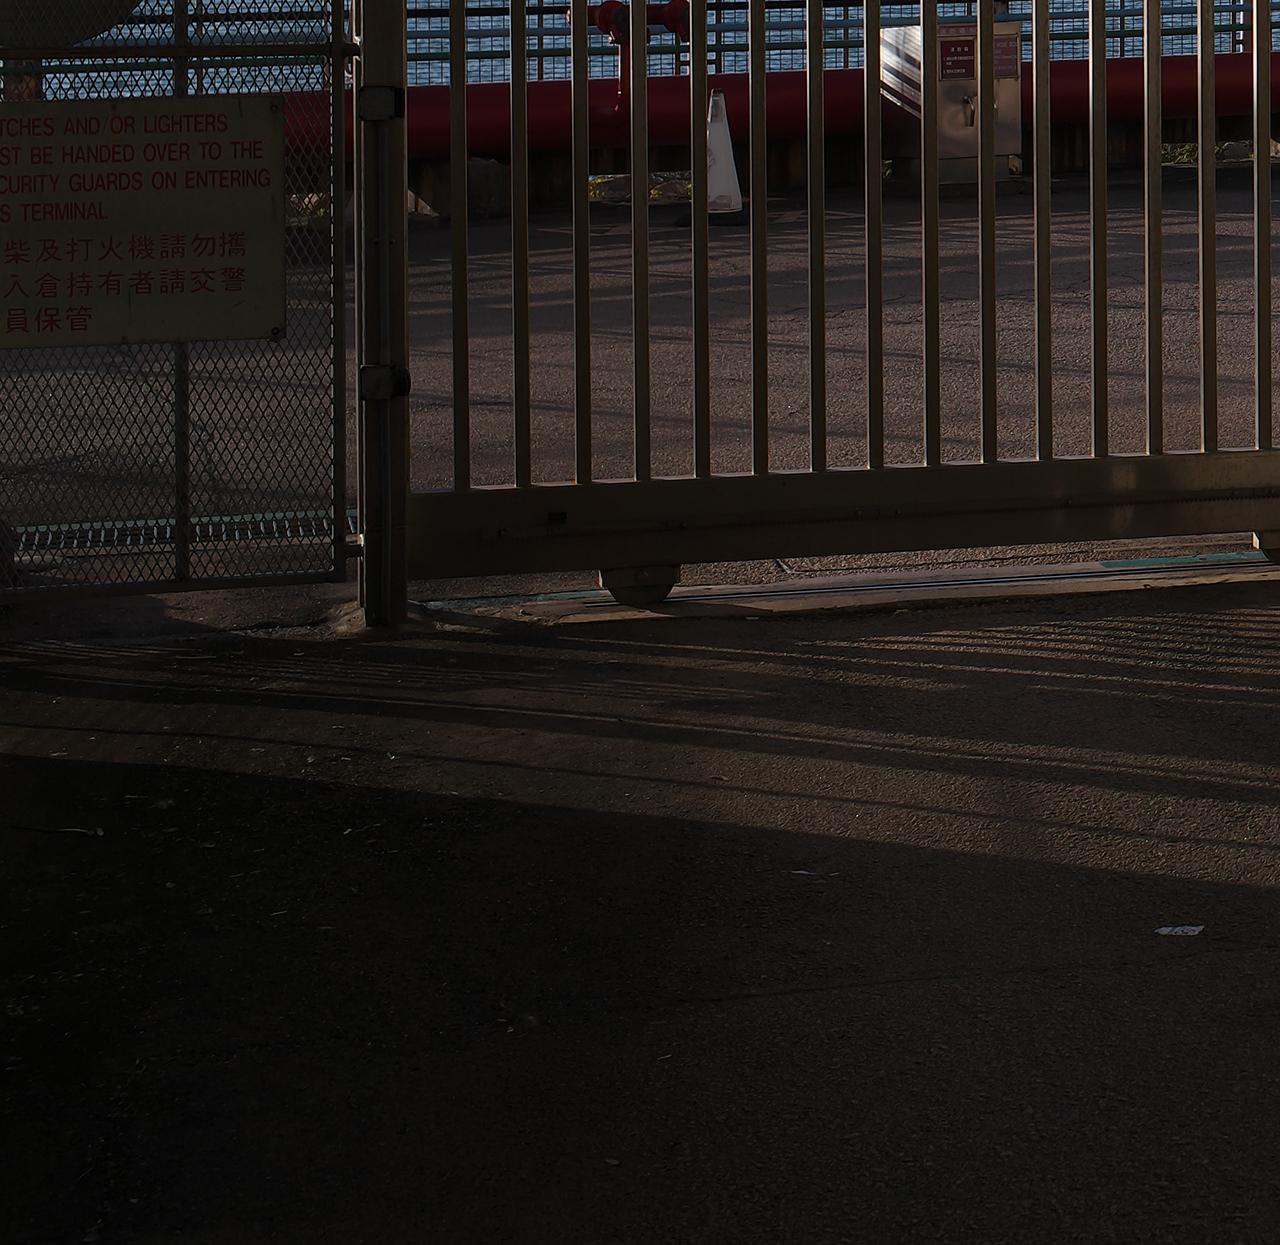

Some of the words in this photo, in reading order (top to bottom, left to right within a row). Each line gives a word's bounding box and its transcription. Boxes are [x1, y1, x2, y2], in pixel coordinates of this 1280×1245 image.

[63, 115, 136, 137] AND/OR
[144, 114, 228, 134] LIGHTERS
[31, 146, 53, 165] BE
[62, 144, 135, 165] HANDED
[143, 142, 190, 163] OVER
[200, 142, 222, 161] TO
[230, 141, 262, 160] THE
[69, 172, 143, 193] GUARDS
[151, 171, 177, 191] ON
[185, 168, 271, 189] ENTERING
[20, 202, 108, 222] TERMINAL
[3, 231, 246, 265] 柴及打火機請勿攜
[3, 266, 246, 299] 入倉持有者請交警
[5, 305, 92, 334] 員保管
